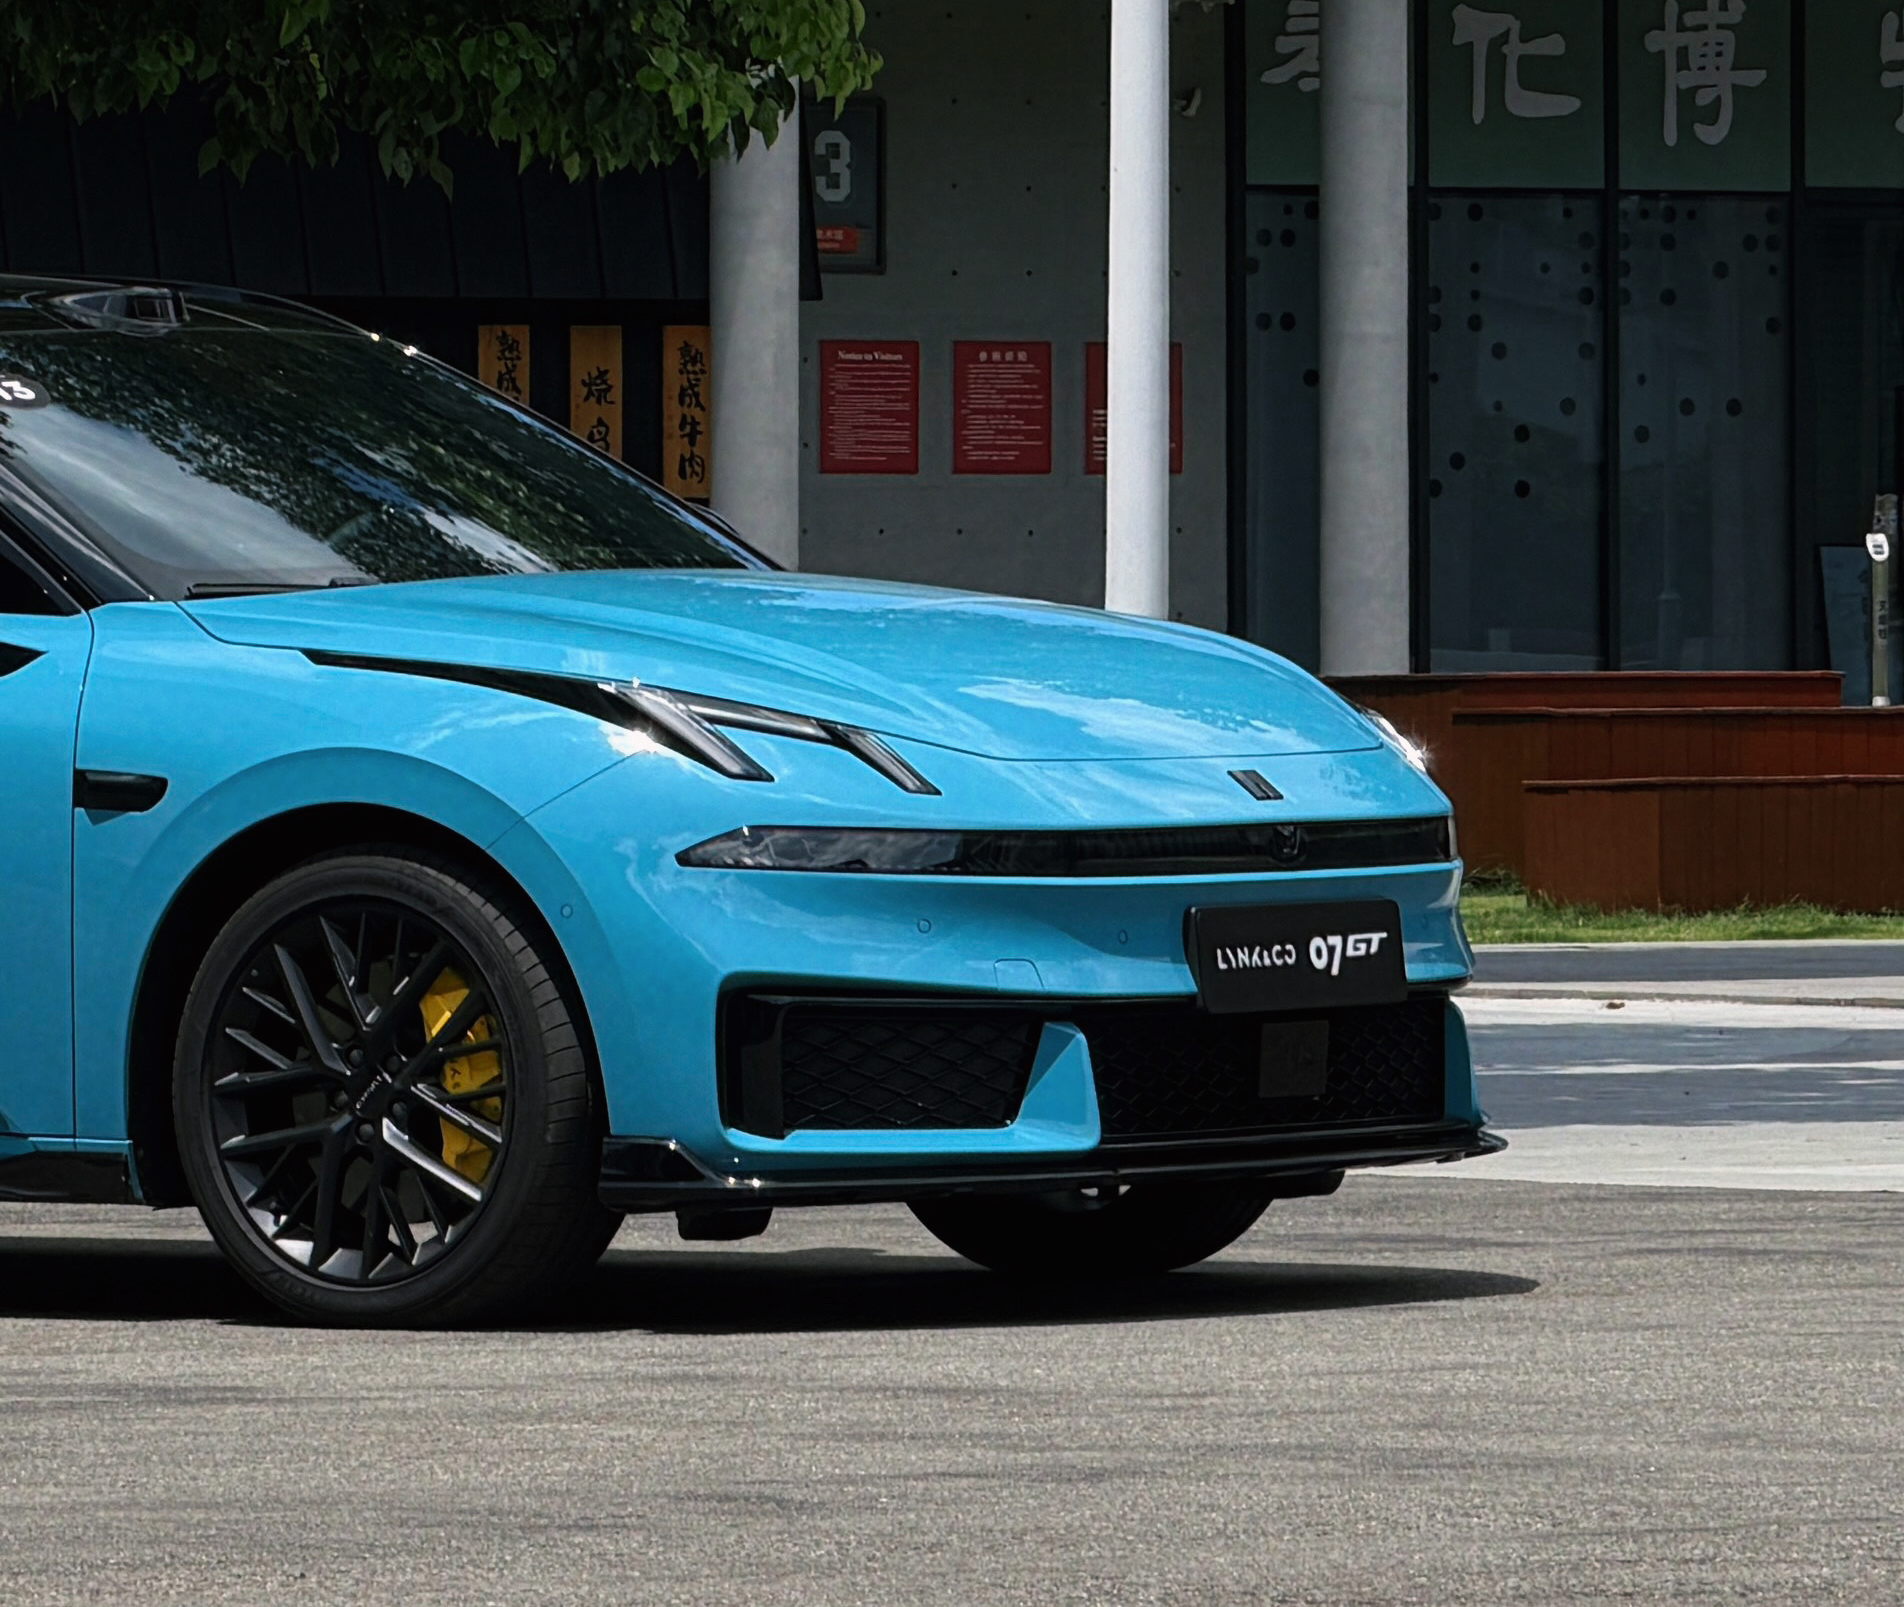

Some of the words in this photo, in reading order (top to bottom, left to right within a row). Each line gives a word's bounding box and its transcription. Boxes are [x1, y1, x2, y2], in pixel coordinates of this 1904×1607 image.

[814, 129, 852, 203] 3
[496, 329, 523, 402] 熟成
[677, 340, 707, 484] 熟成牛肉
[1216, 943, 1297, 971] LYNK&CO
